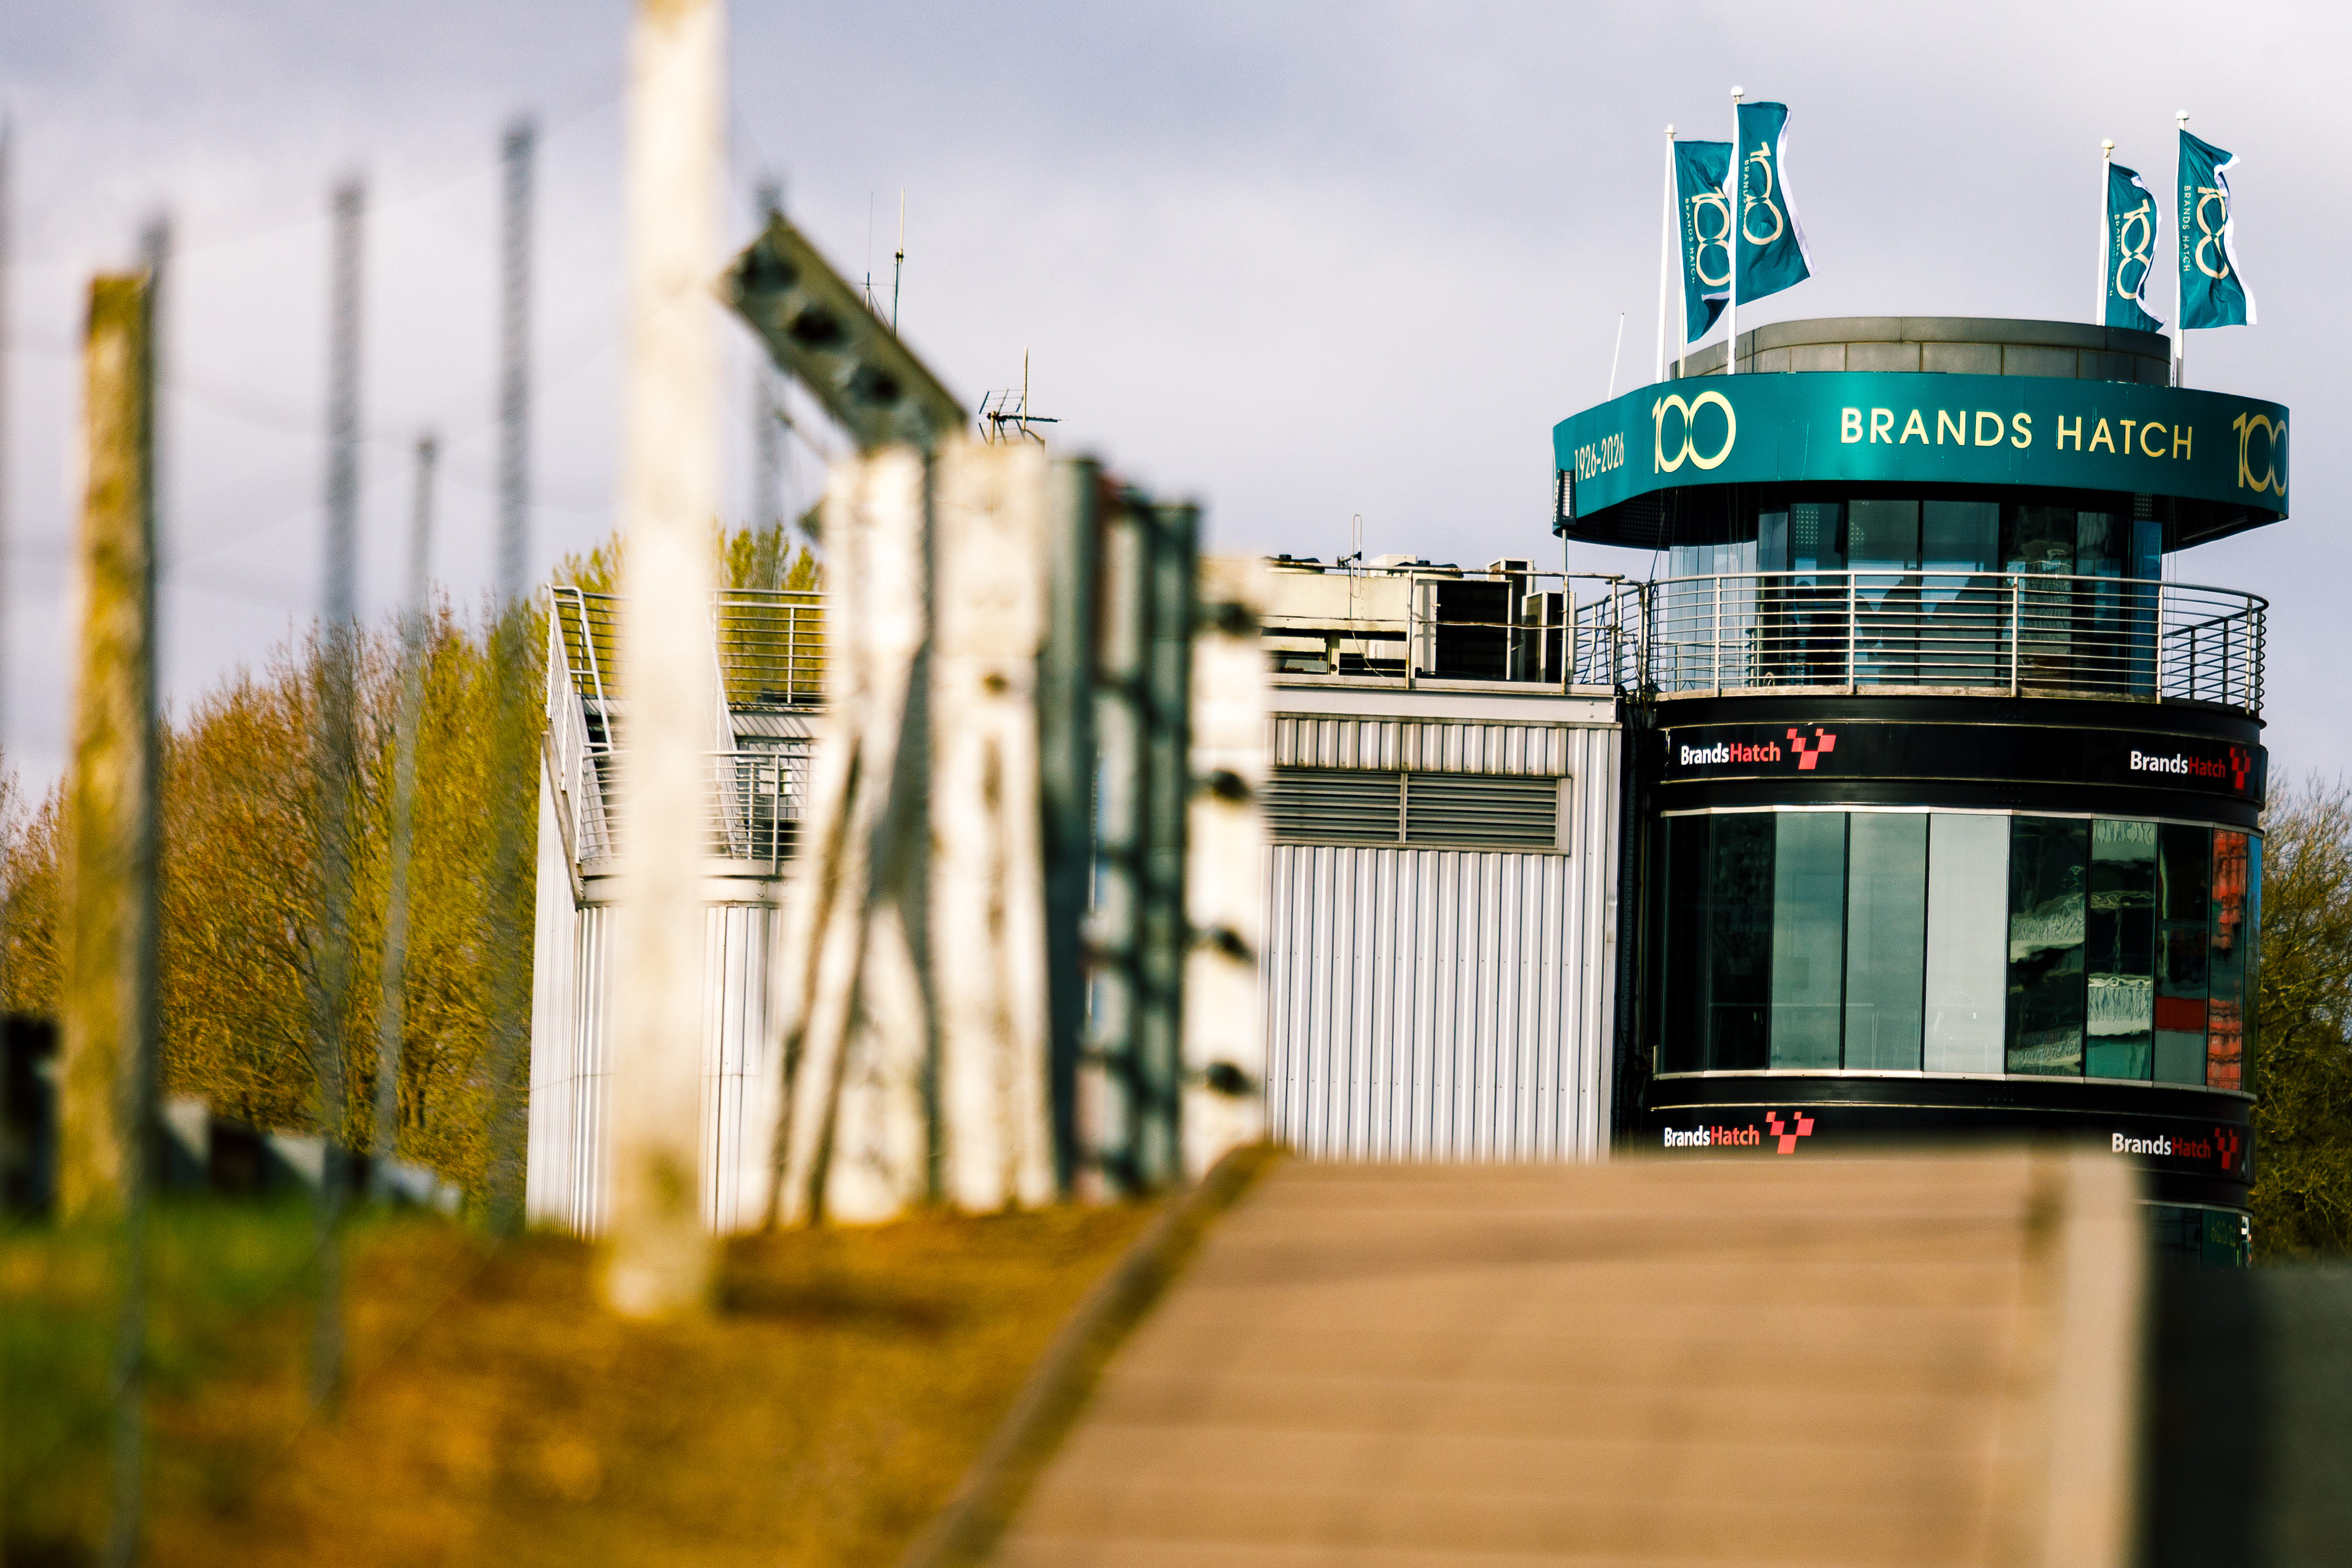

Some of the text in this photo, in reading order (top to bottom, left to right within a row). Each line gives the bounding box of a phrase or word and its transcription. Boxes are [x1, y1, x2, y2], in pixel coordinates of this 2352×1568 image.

[1742, 141, 1783, 246] 100
[1685, 198, 1695, 242] BRANDS
[1691, 186, 1731, 287] 100
[2182, 185, 2192, 272] BRANDS HATCH
[2117, 199, 2151, 300] 100
[1575, 432, 1624, 483] 1926-2026
[1652, 391, 1736, 474] 100
[1841, 408, 2192, 460] BRANDS HATCH
[2232, 412, 2288, 497] 100
[1681, 741, 1781, 766] BrandsHatch
[2130, 750, 2225, 778] BrandsHatch
[1664, 1124, 1760, 1147] BrandsHatch
[2112, 1133, 2211, 1159] BrandsHatch
